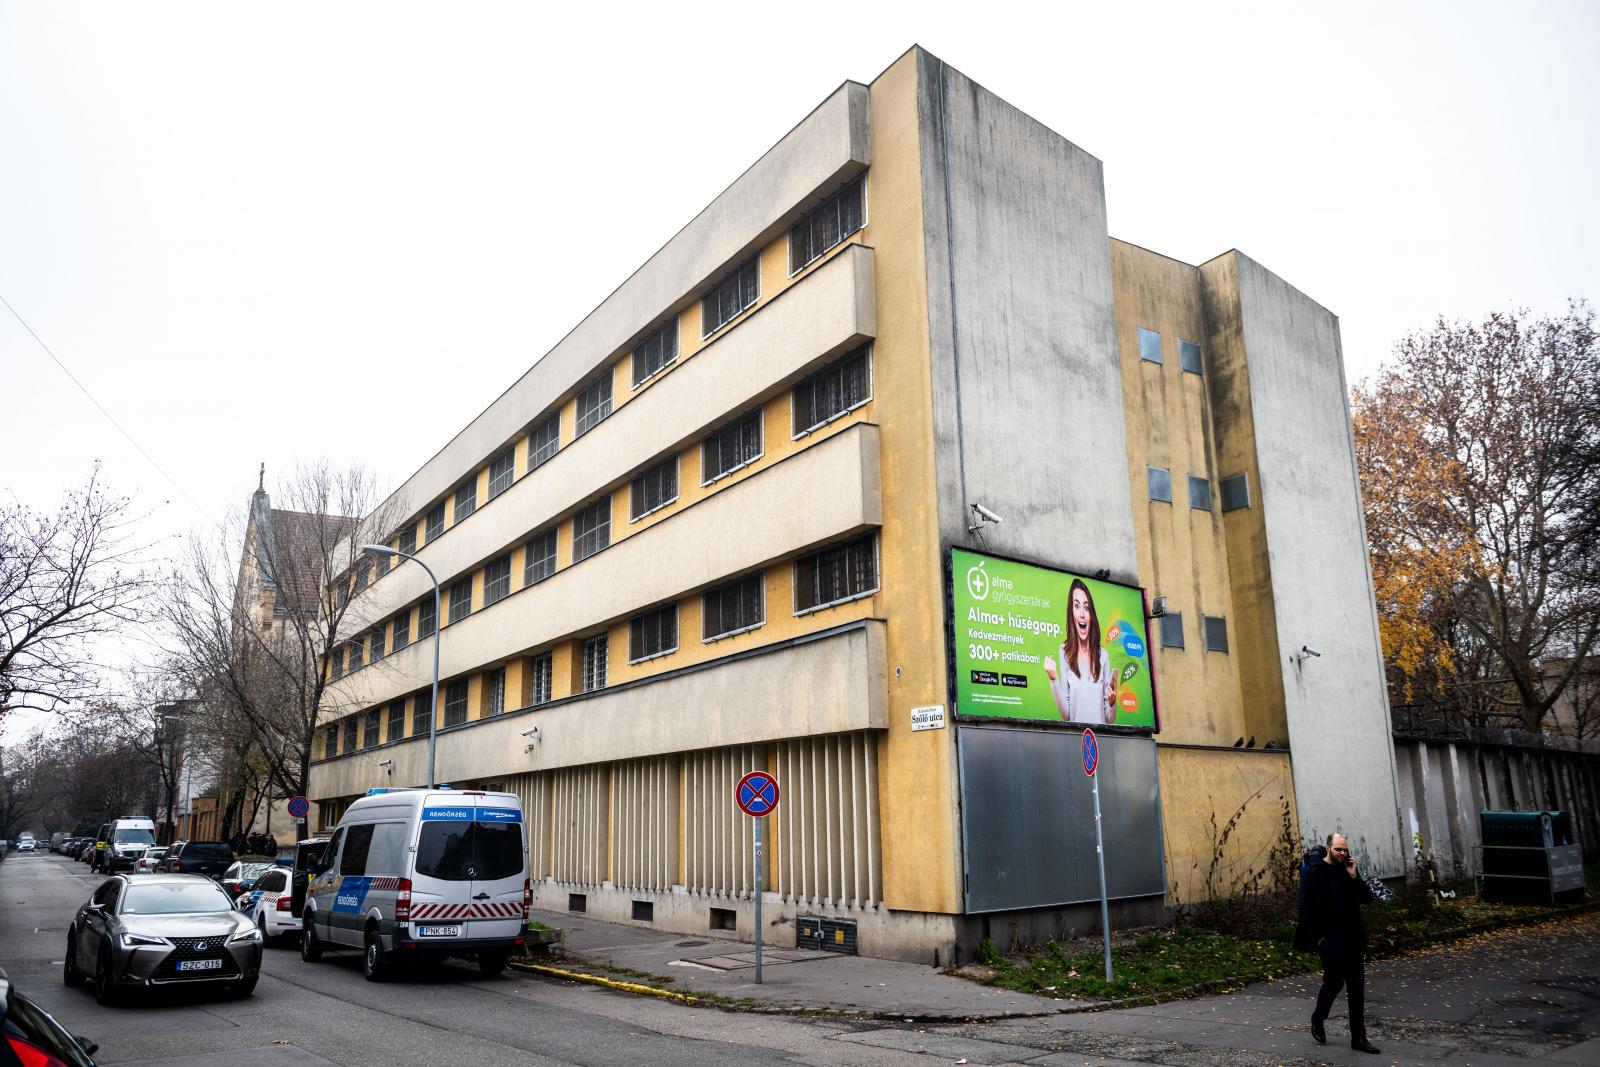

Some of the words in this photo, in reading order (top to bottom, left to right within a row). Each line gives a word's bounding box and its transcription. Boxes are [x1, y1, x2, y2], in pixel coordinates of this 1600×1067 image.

[992, 576, 1013, 590] alma
[992, 591, 1050, 609] gyógyszertárak
[968, 607, 1006, 625] Alma+
[1008, 612, 1063, 638] hűségapp.
[968, 628, 1025, 646] Kedvezmények
[969, 643, 1000, 661] 300+
[1001, 651, 1041, 664] patikában!
[912, 713, 929, 724] Szőlő
[929, 713, 943, 722] utca
[429, 810, 467, 818] RENDŐRSÉG
[425, 927, 456, 936] PNK-854
[183, 960, 221, 970] SZC-015
